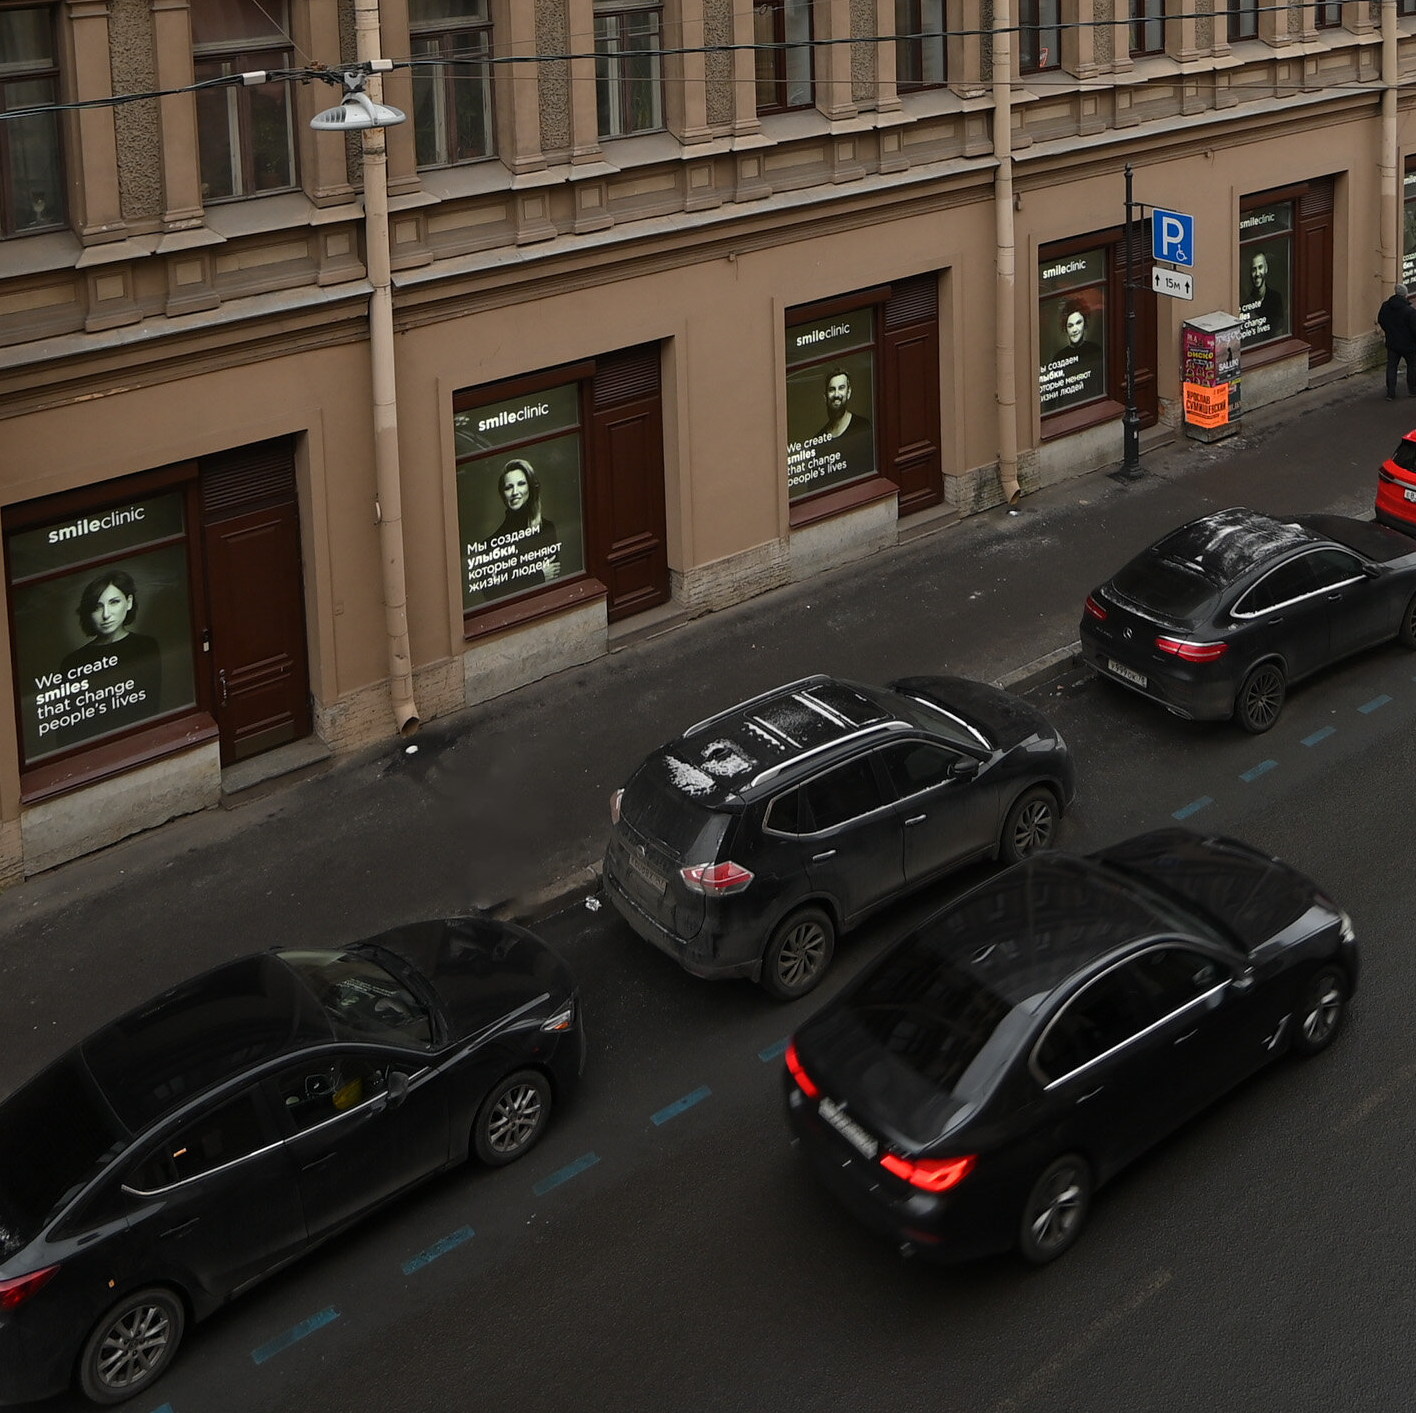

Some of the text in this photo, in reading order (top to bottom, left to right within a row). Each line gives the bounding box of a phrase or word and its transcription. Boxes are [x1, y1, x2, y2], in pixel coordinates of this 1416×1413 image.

[1162, 216, 1185, 256] P
[1042, 260, 1087, 279] smileclinic
[796, 323, 851, 347] smileclinic
[478, 403, 549, 432] smileclinic
[787, 432, 833, 454] We create
[787, 448, 816, 465] smiles
[808, 452, 841, 469] change
[827, 460, 847, 474] lives
[48, 507, 146, 544] smileclinic
[467, 524, 541, 555] Мы создаем
[467, 544, 519, 570] улыбки,
[468, 542, 563, 581] которые меняют
[469, 556, 551, 594] жизни людей
[35, 655, 119, 690] We create
[36, 679, 90, 705] smiles
[37, 679, 135, 719] that change
[38, 689, 147, 737] people's lives
